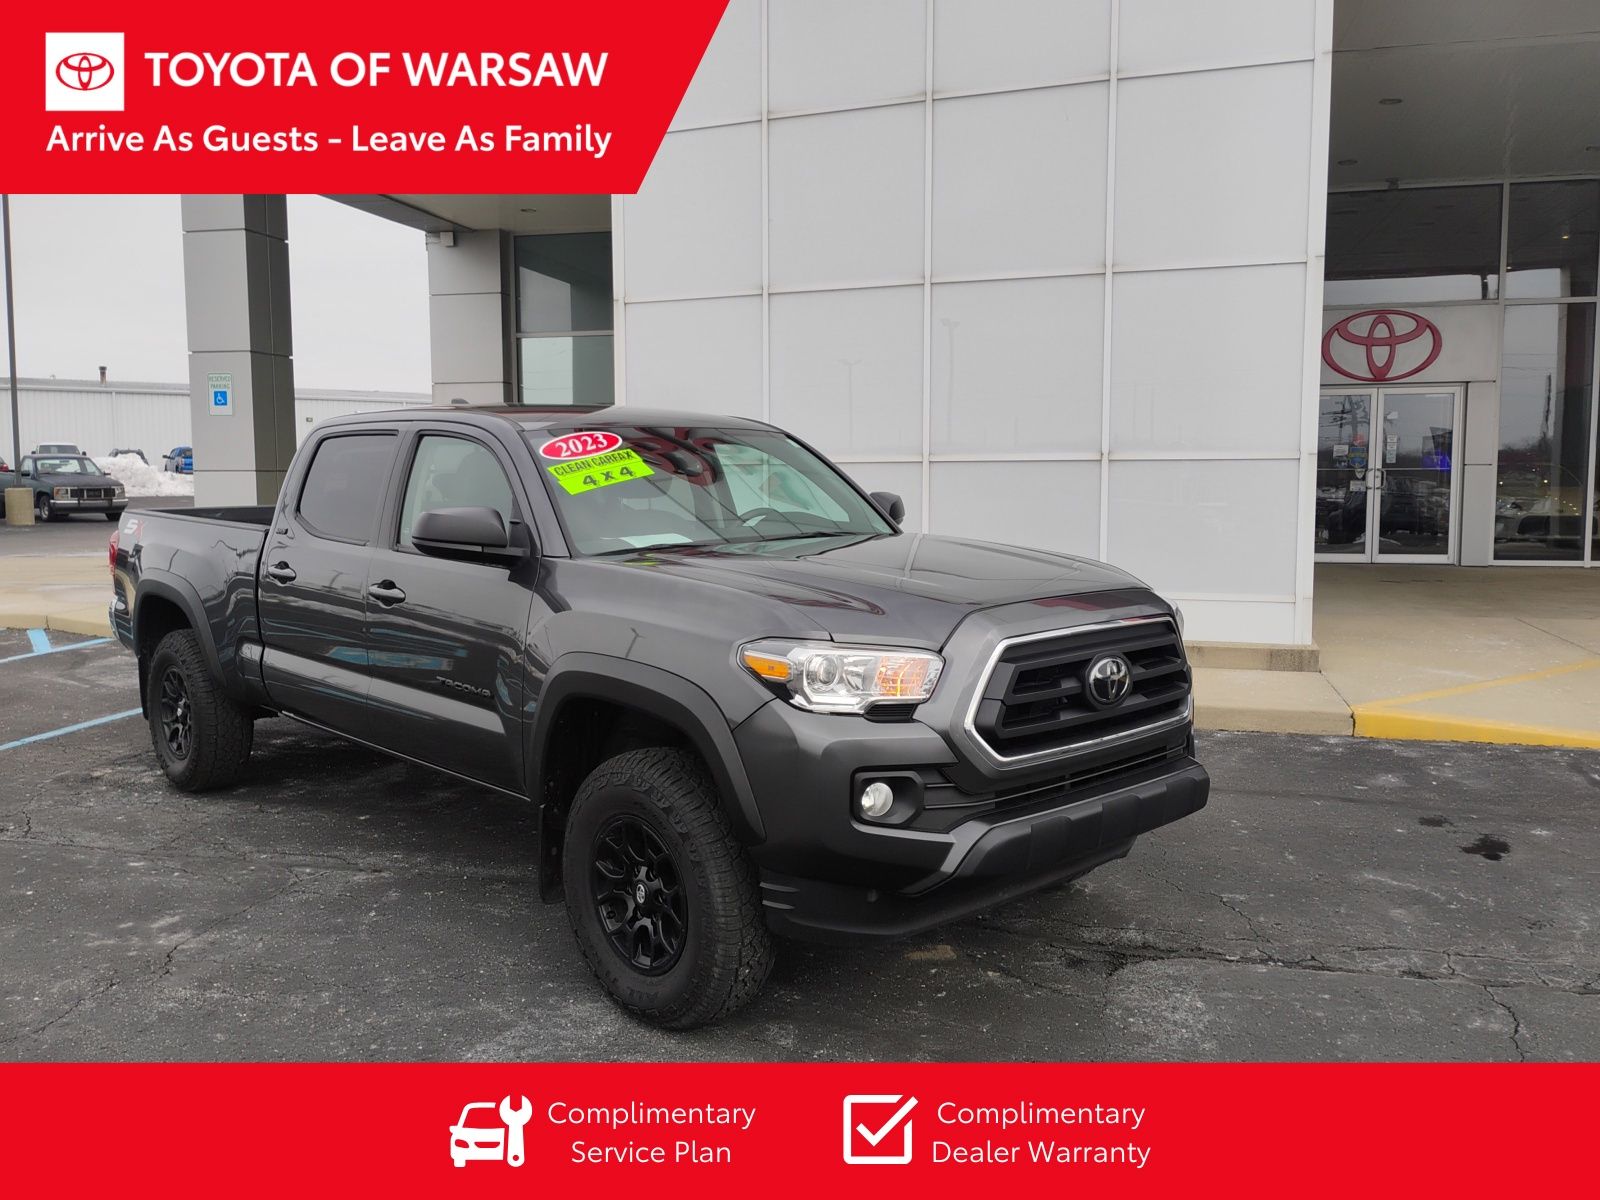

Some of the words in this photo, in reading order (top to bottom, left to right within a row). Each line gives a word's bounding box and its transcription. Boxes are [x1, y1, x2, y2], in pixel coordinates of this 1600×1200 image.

[555, 433, 608, 457] 2023
[554, 459, 592, 476] CLEAN
[592, 450, 634, 467] CARFAX
[436, 676, 491, 697] TACOMA
